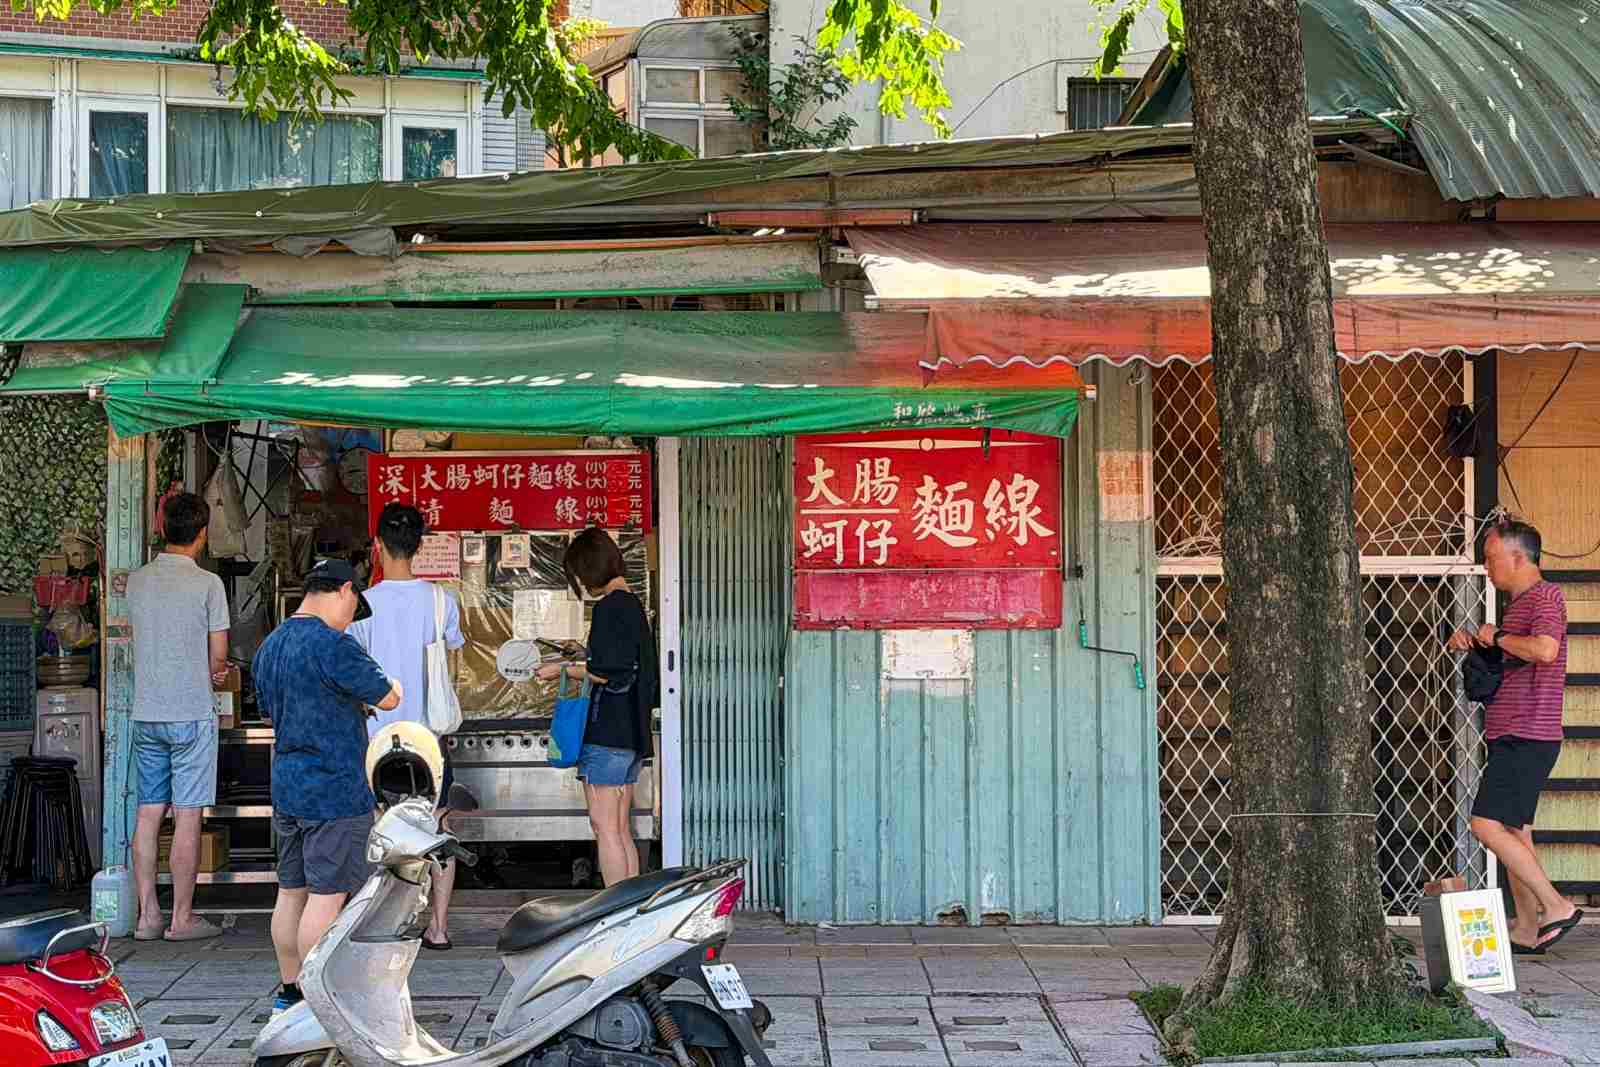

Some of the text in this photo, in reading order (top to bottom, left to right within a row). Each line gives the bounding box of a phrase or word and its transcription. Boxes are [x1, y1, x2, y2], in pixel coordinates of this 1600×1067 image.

[420, 462, 582, 490] 大腸蚵仔麵線
[800, 456, 901, 506] 大腸
[911, 473, 1056, 548] 麵線
[800, 518, 899, 566] 蚵仔
